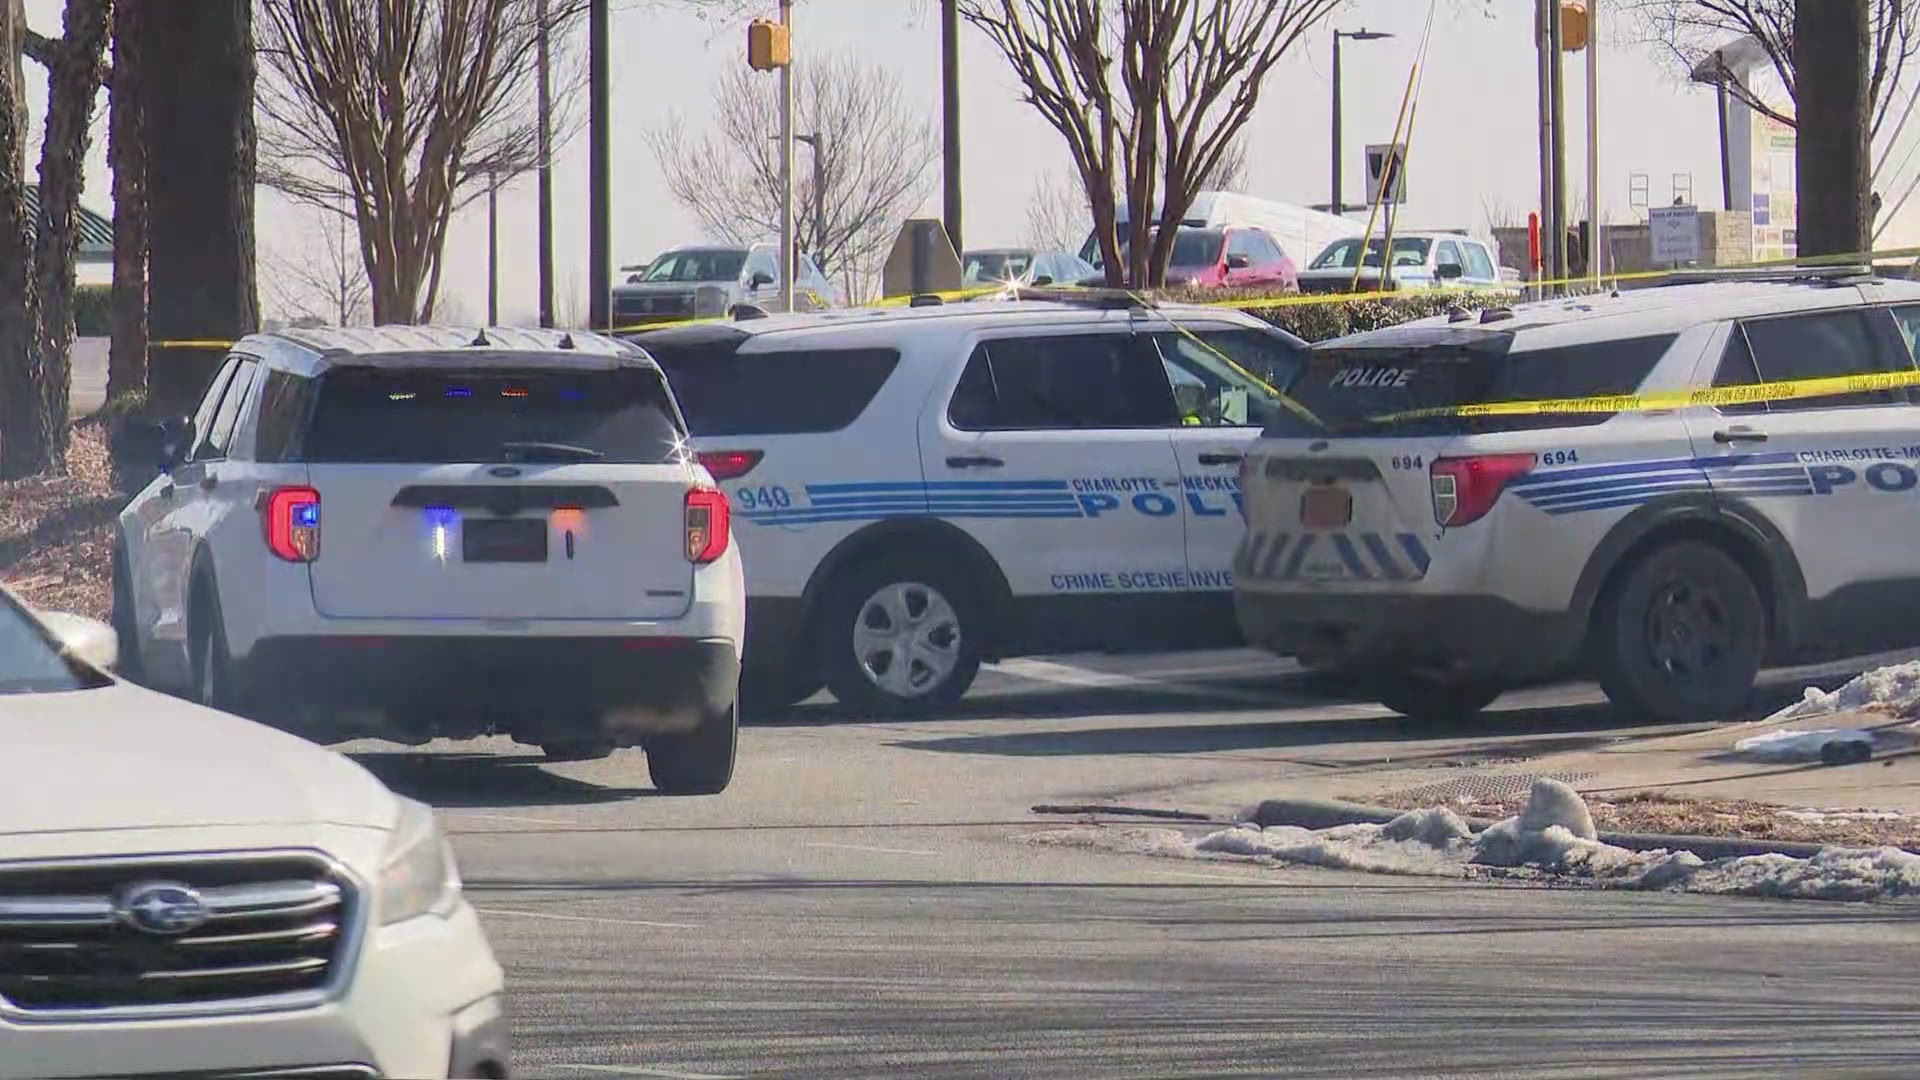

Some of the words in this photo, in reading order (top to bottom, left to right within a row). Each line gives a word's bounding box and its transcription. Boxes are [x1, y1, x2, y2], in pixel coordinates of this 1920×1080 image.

[1328, 367, 1416, 388] POLICE
[1543, 450, 1578, 465] 694
[1072, 478, 1158, 492] CHARLOTTE
[737, 486, 791, 508] 940
[1051, 573, 1114, 589] CRIME
[1118, 571, 1186, 589] SCENE
[1189, 570, 1233, 588] INVE
